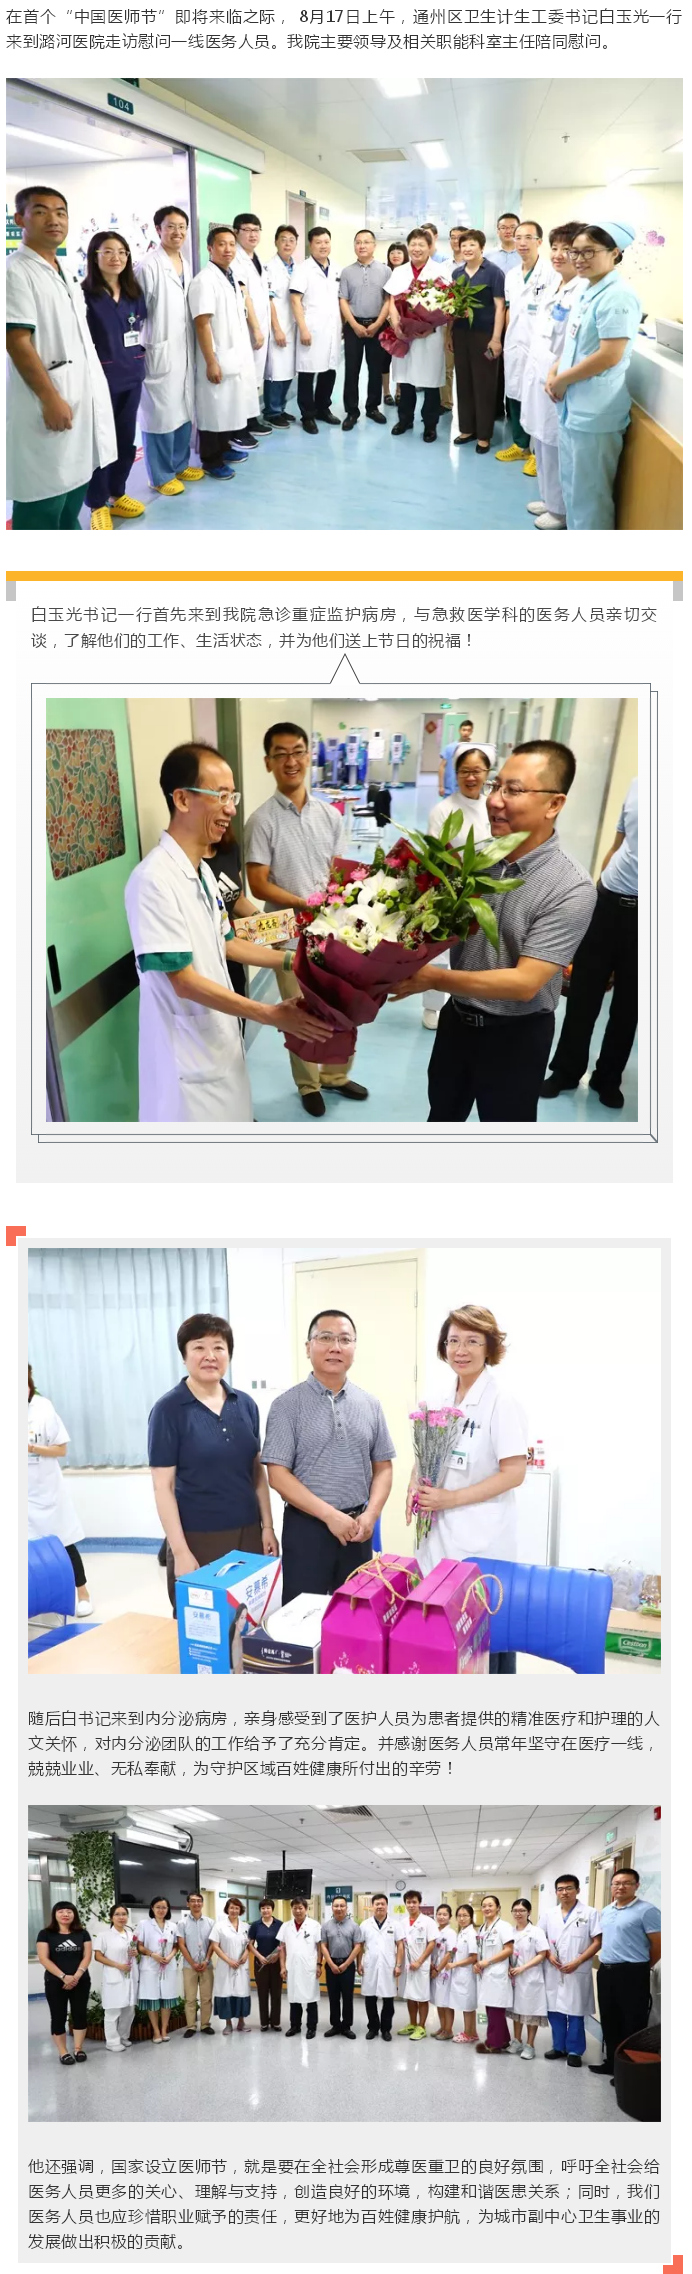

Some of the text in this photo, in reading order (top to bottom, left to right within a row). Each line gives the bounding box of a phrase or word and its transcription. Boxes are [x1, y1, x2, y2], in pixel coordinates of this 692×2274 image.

[113, 97, 130, 111] 104
[245, 1574, 269, 1600] 安慕希
